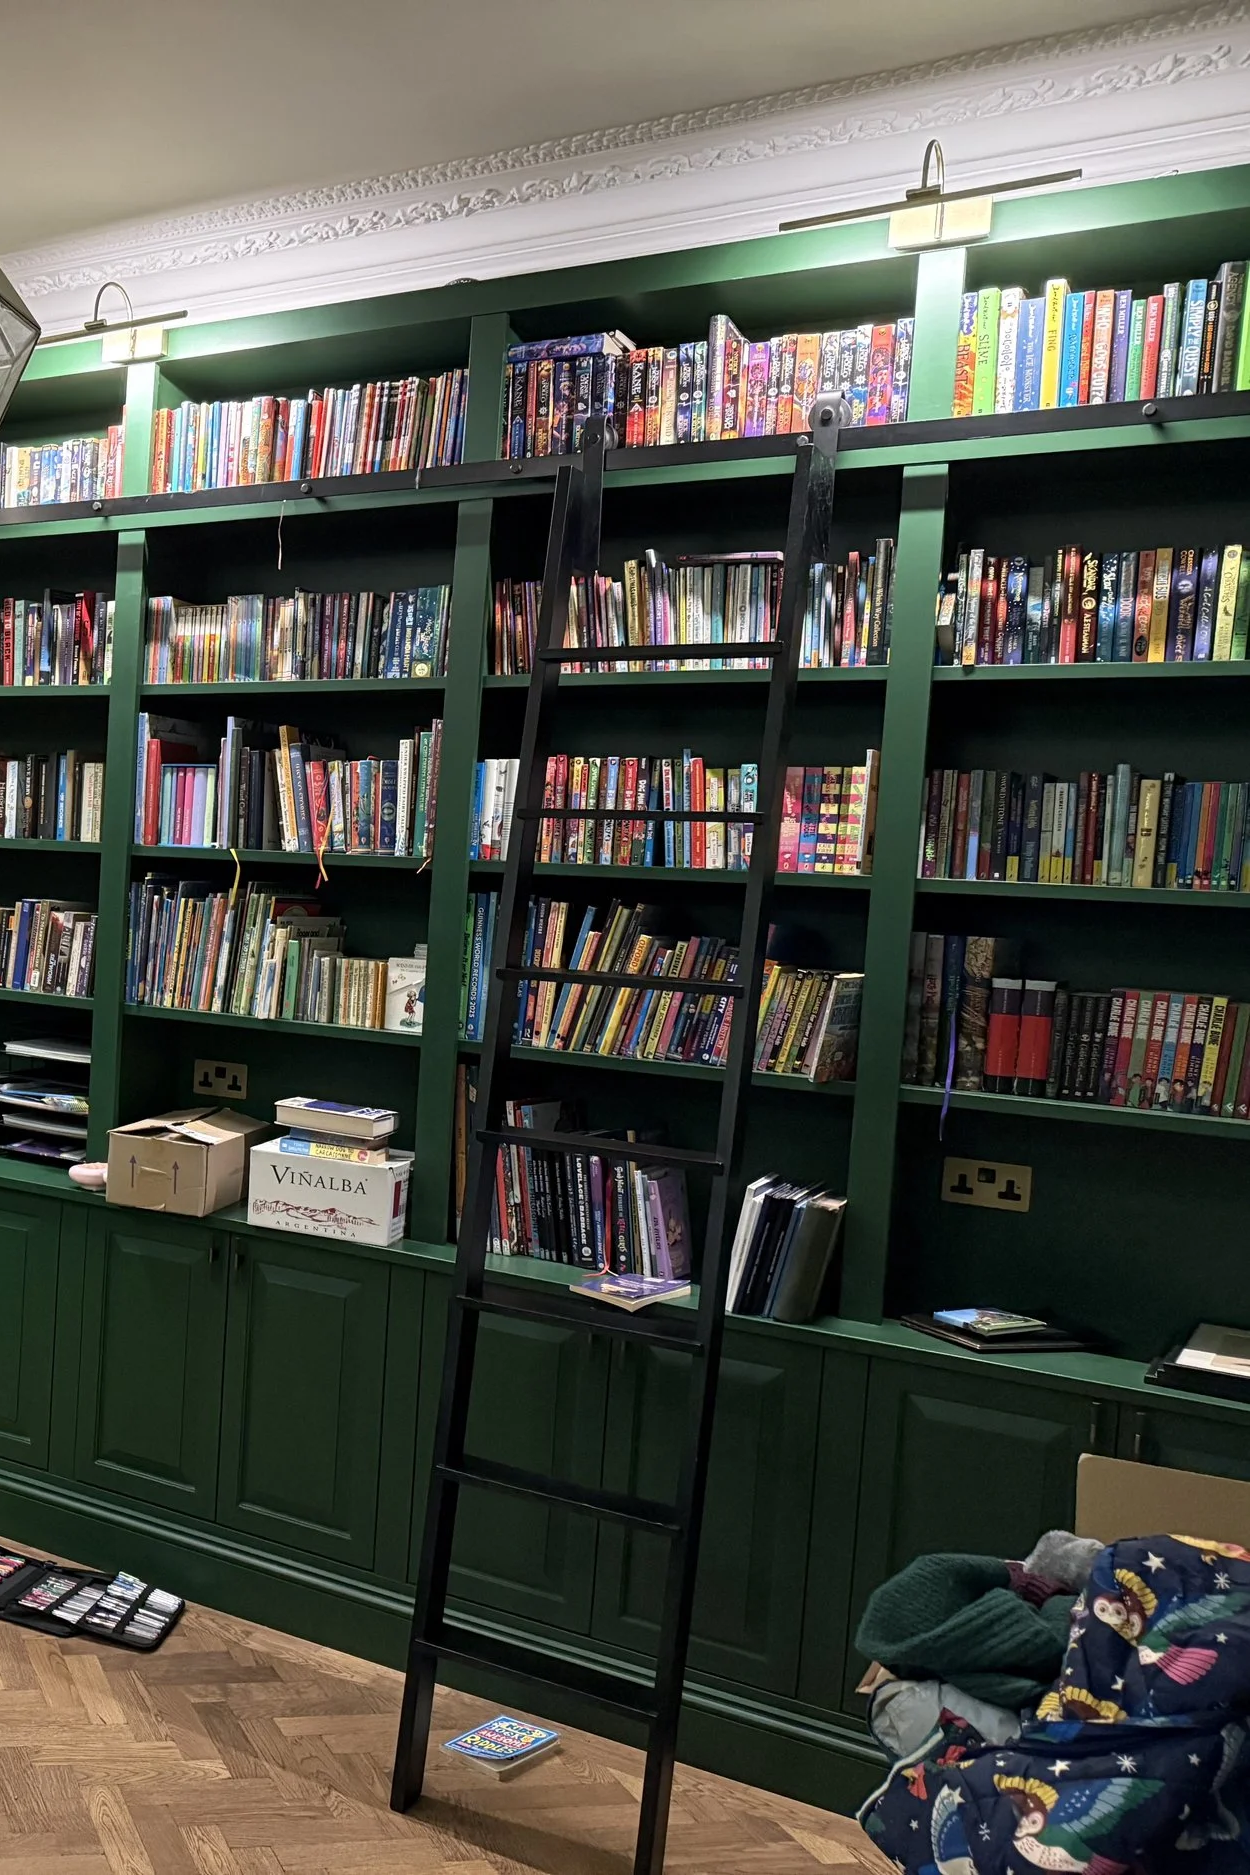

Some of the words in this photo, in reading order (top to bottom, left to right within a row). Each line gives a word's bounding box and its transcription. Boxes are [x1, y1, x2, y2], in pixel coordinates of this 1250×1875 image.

[1226, 272, 1239, 306] AGENCY
[1119, 295, 1128, 309] BEN
[1150, 303, 1159, 315] BEN
[1188, 300, 1204, 337] SIMPLY
[1148, 318, 1157, 342] MILLER
[1047, 330, 1057, 352] FING
[856, 343, 865, 371] APOLLO
[956, 344, 971, 384] BEAST
[1025, 354, 1034, 367] ICE
[1184, 346, 1200, 378] QUEST
[635, 363, 644, 394] KANE
[1023, 369, 1032, 403] MONSTER
[540, 378, 549, 403] APOLLO
[1086, 560, 1098, 593] SKANDAR
[873, 608, 882, 620] Way
[1120, 597, 1133, 618] DOOR
[872, 620, 881, 647] Collection
[402, 655, 411, 672] HART
[136, 746, 145, 769] GIANT
[638, 780, 647, 792] DOG
[637, 793, 646, 805] MAN
[475, 907, 484, 941] GUINNESS
[473, 943, 482, 967] WORLD
[630, 939, 647, 967] OXFORD
[670, 944, 685, 976] IMPOSSIBLE
[46, 953, 55, 985] SILKWORM
[470, 969, 479, 1001] RECORDS
[516, 980, 525, 998] ATLAS
[791, 980, 801, 995] BRAIN
[817, 982, 828, 996] BRAIN
[468, 1002, 477, 1018] 2025
[717, 997, 727, 1014] CITY
[785, 994, 797, 1013] GAMES
[811, 995, 822, 1014] GAMES
[723, 1005, 734, 1022] MADE
[782, 1012, 791, 1021] for
[652, 1012, 666, 1038] SCHREIBER
[778, 1021, 788, 1036] clever
[804, 1022, 814, 1037] clever
[1107, 1022, 1118, 1037] BONE
[1121, 1024, 1133, 1039] BONE
[1151, 1026, 1163, 1041] BONE
[716, 1023, 730, 1049] HISTORY
[800, 1037, 809, 1047] kids
[1193, 1029, 1206, 1045] BONE
[1208, 1030, 1221, 1046] BONE
[1146, 1051, 1155, 1073] NIMMO
[1151, 1054, 1160, 1073] JENNY
[1187, 1055, 1196, 1077] NIMMO
[270, 1164, 367, 1195] VIÑALBA
[275, 1220, 356, 1238] ARGENTINA
[463, 1735, 516, 1754] RIDDLES
[477, 1730, 531, 1750] AWESOME
